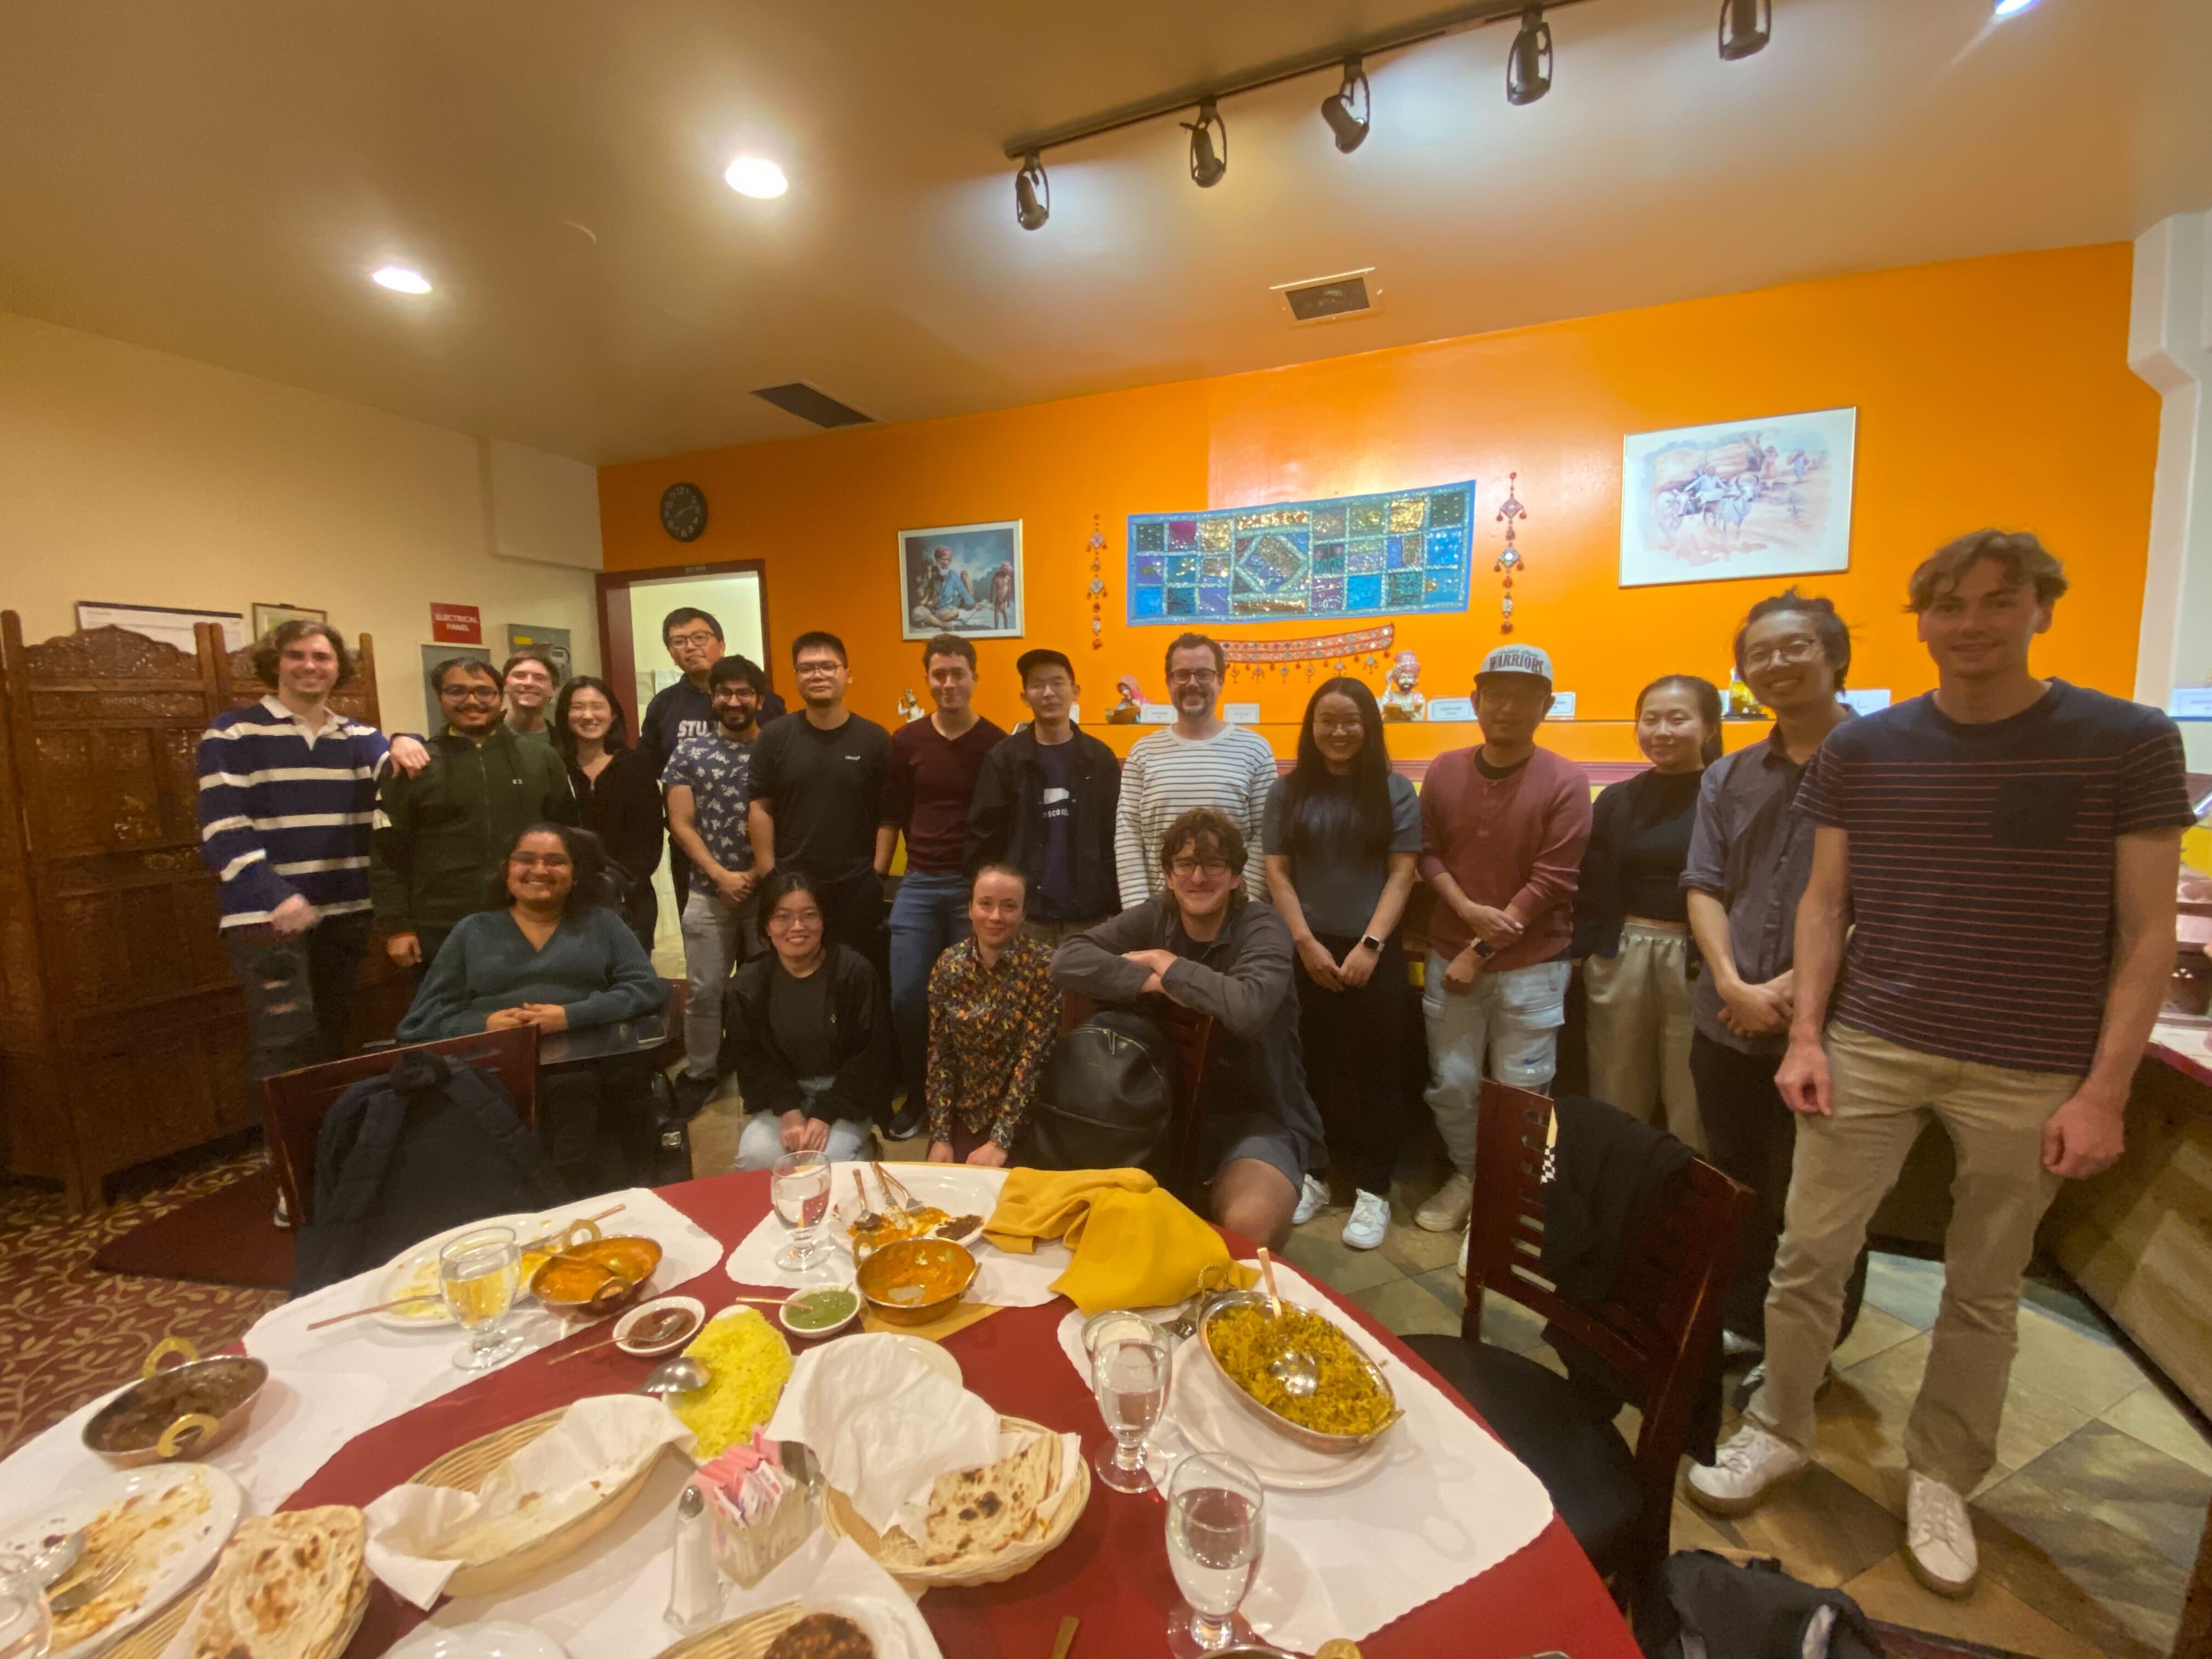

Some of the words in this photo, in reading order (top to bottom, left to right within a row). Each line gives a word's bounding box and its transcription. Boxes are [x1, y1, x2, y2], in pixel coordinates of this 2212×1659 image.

[435, 613, 479, 623] ELECTRICAL
[446, 623, 470, 631] PANEL
[1489, 653, 1544, 675] WARRIORS
